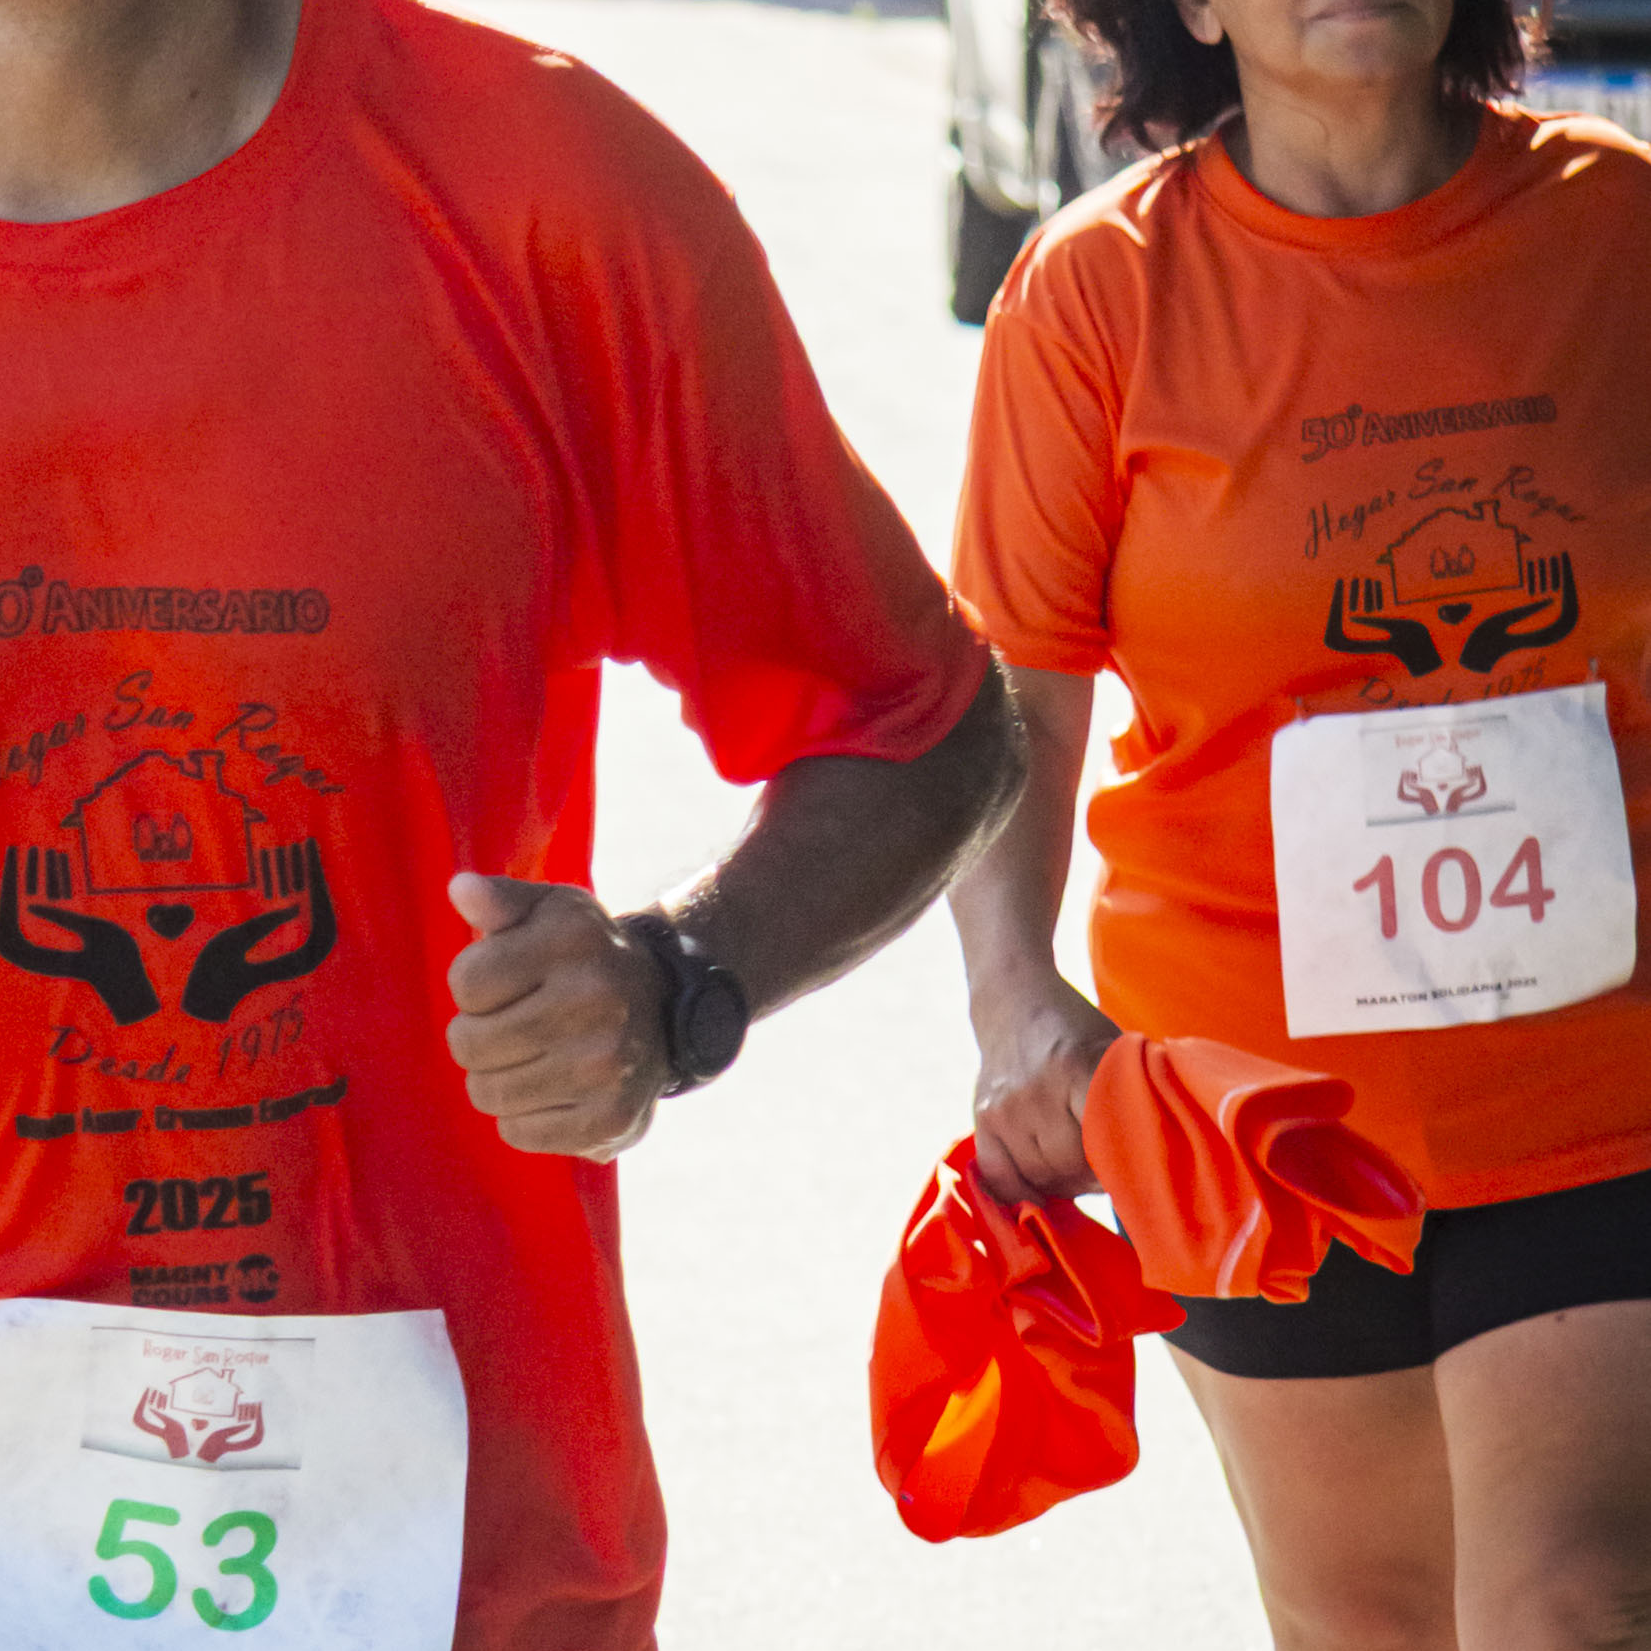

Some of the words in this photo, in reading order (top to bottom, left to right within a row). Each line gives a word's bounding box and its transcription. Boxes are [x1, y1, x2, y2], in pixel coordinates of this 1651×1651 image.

[1407, 457, 1478, 501] San
[104, 669, 195, 732] San
[1352, 835, 1556, 941] 104
[48, 1024, 191, 1084] Desde
[123, 1170, 272, 1237] 2025
[88, 1498, 279, 1632] 53
